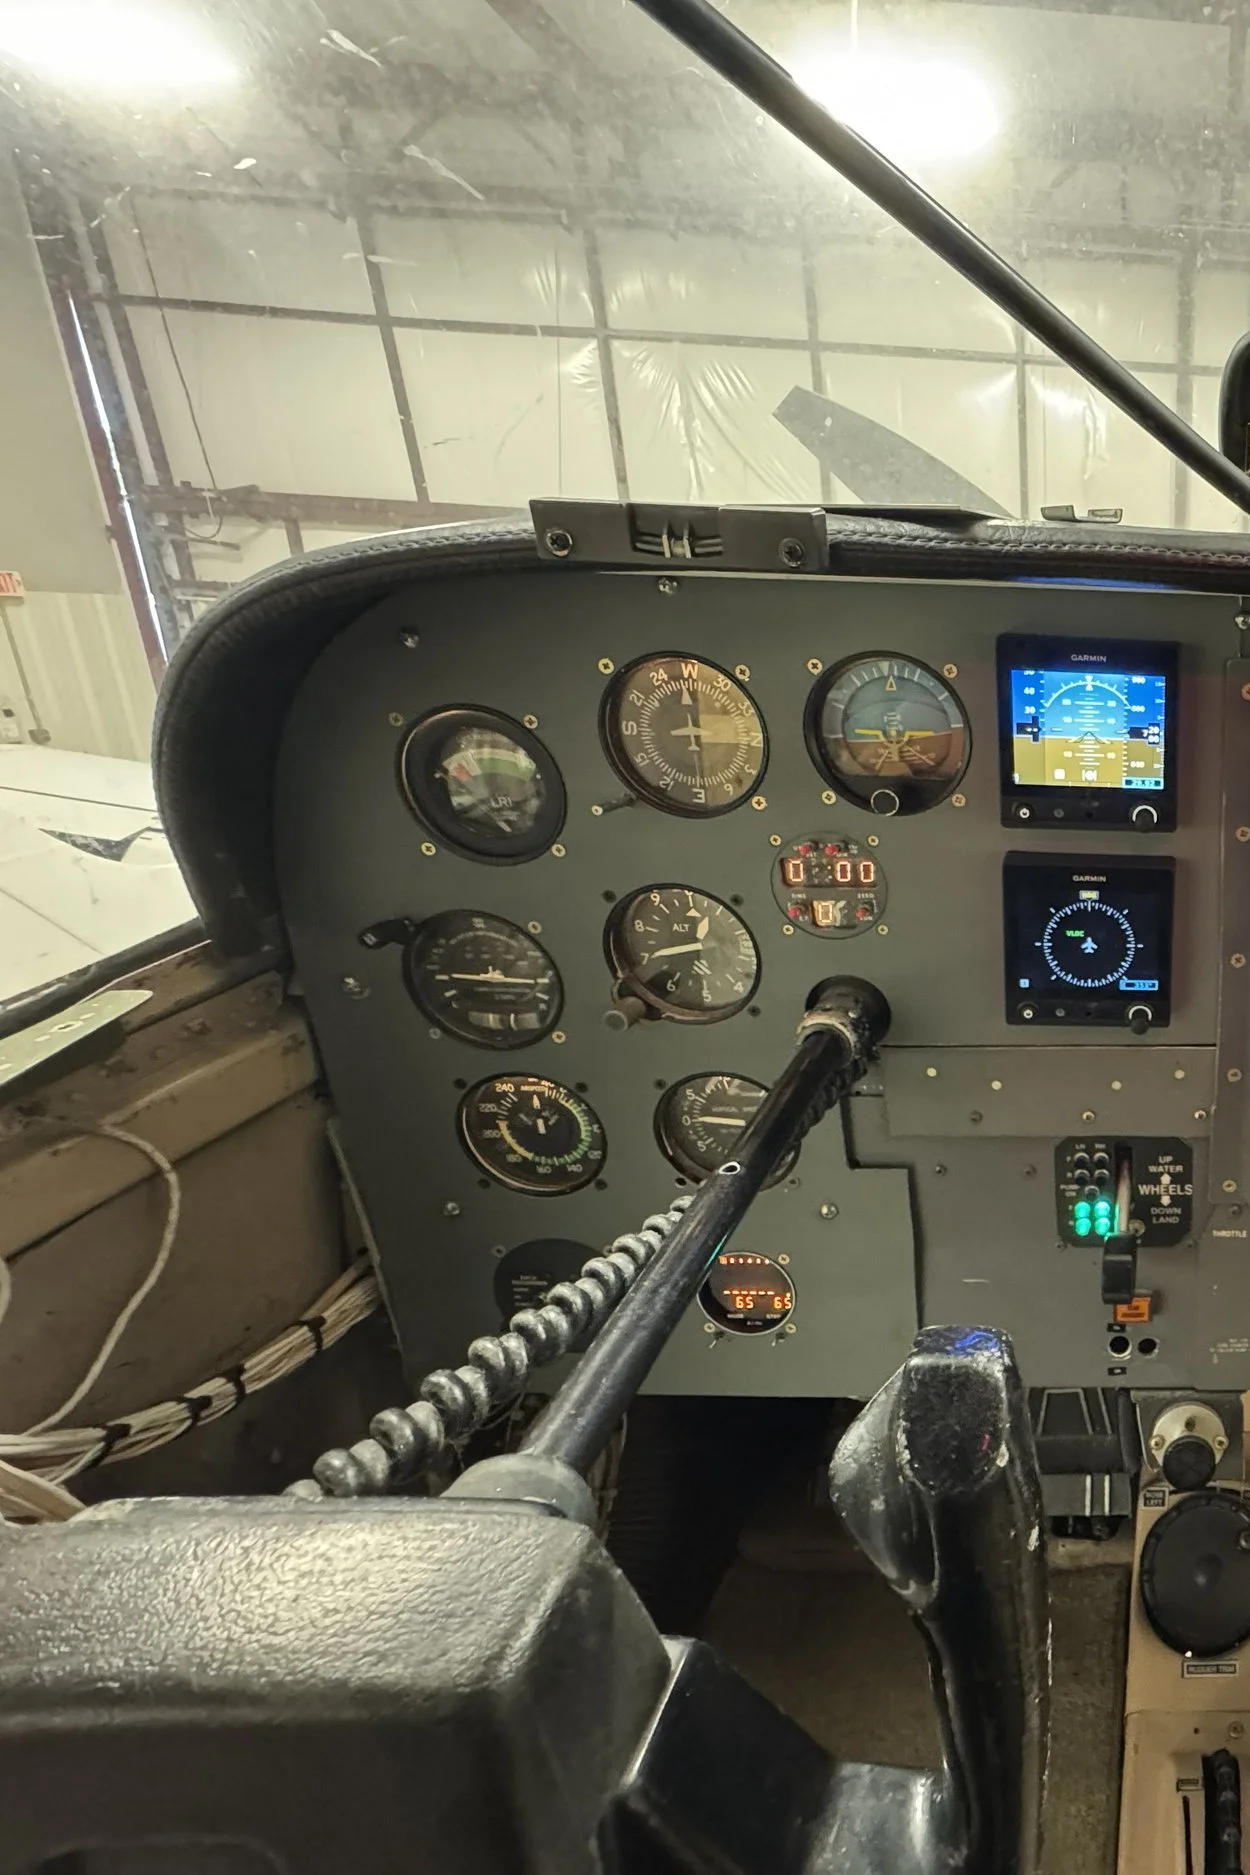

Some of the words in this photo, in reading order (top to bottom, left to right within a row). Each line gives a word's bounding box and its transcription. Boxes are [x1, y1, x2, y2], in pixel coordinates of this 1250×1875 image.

[1071, 654, 1107, 662] GARMIN
[650, 668, 668, 686] 24
[681, 663, 698, 679] W
[713, 675, 731, 692] 30
[630, 689, 645, 706] 21
[621, 720, 637, 735] S
[749, 731, 763, 747] N
[634, 753, 649, 767] 15
[659, 776, 675, 791] 12
[724, 783, 734, 796] 6
[692, 789, 706, 804] E
[651, 893, 660, 905] 9
[634, 919, 645, 932] 8
[672, 923, 690, 932] ALT
[640, 953, 649, 965] 7
[667, 979, 676, 992] 6
[733, 982, 744, 993] 4
[702, 990, 712, 1002] 5
[495, 1083, 514, 1092] 240
[686, 1089, 697, 1100] 5
[478, 1103, 497, 1112] 220
[682, 1115, 691, 1126] 0
[697, 1141, 706, 1151] 5
[1159, 1156, 1173, 1164] UP
[1148, 1164, 1184, 1173] WATER
[1138, 1184, 1193, 1196] WHEELS
[1150, 1206, 1181, 1215] DOWN
[1152, 1215, 1180, 1224] LAND
[1213, 1229, 1248, 1238] THROTTLE
[735, 1296, 754, 1309] 65
[774, 1297, 792, 1309] 65
